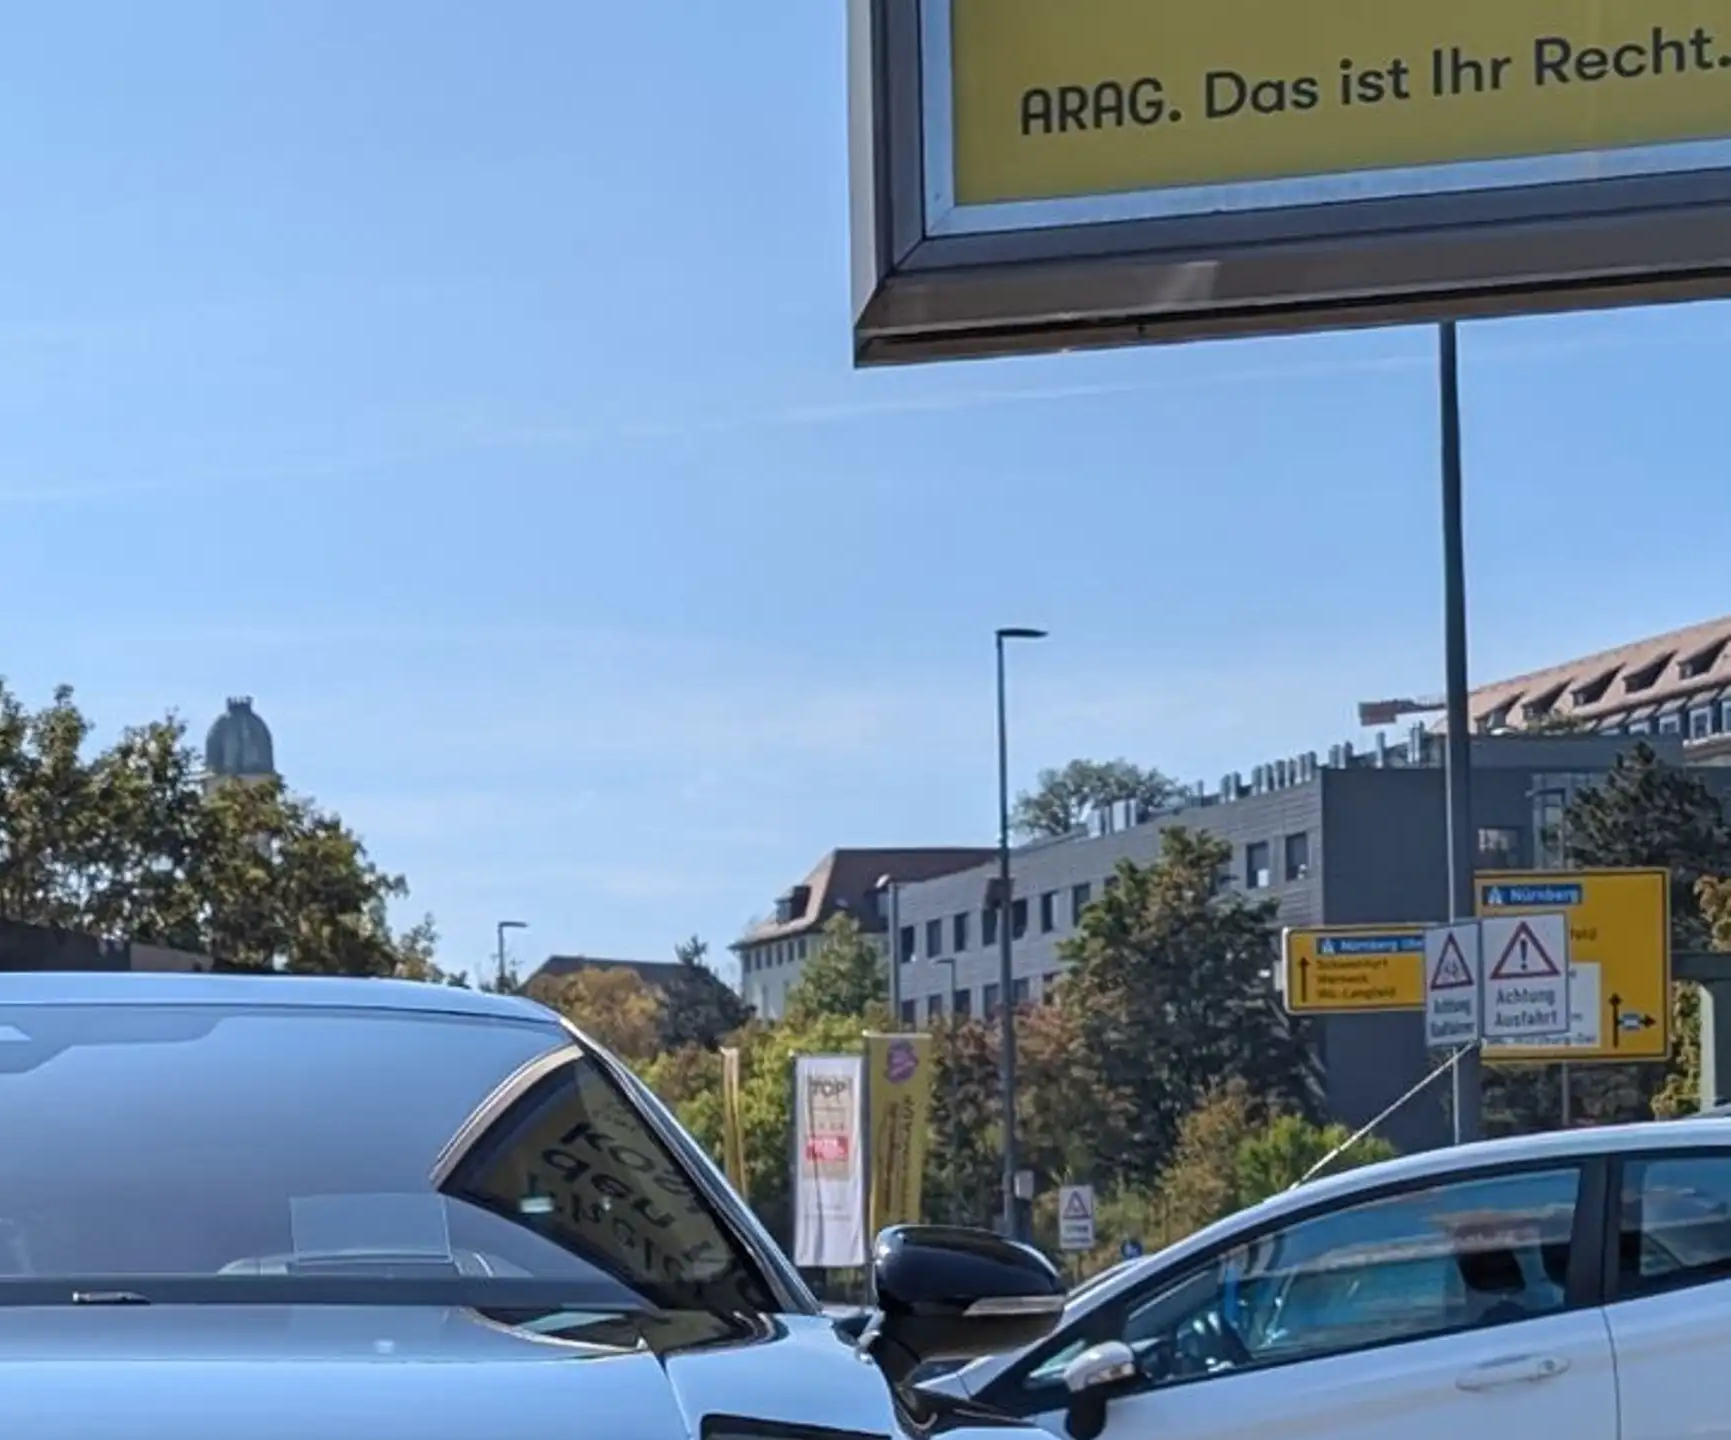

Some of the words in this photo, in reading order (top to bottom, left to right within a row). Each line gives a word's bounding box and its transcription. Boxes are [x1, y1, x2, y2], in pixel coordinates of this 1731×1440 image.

[1020, 77, 1182, 136] ARAG.
[1205, 69, 1319, 121] Das
[1339, 58, 1411, 106] ist
[1433, 47, 1512, 98] Ihr
[1534, 26, 1731, 87] Recht.
[1510, 885, 1578, 905] Nürnberg
[1494, 1008, 1558, 1028] Ausfahrt
